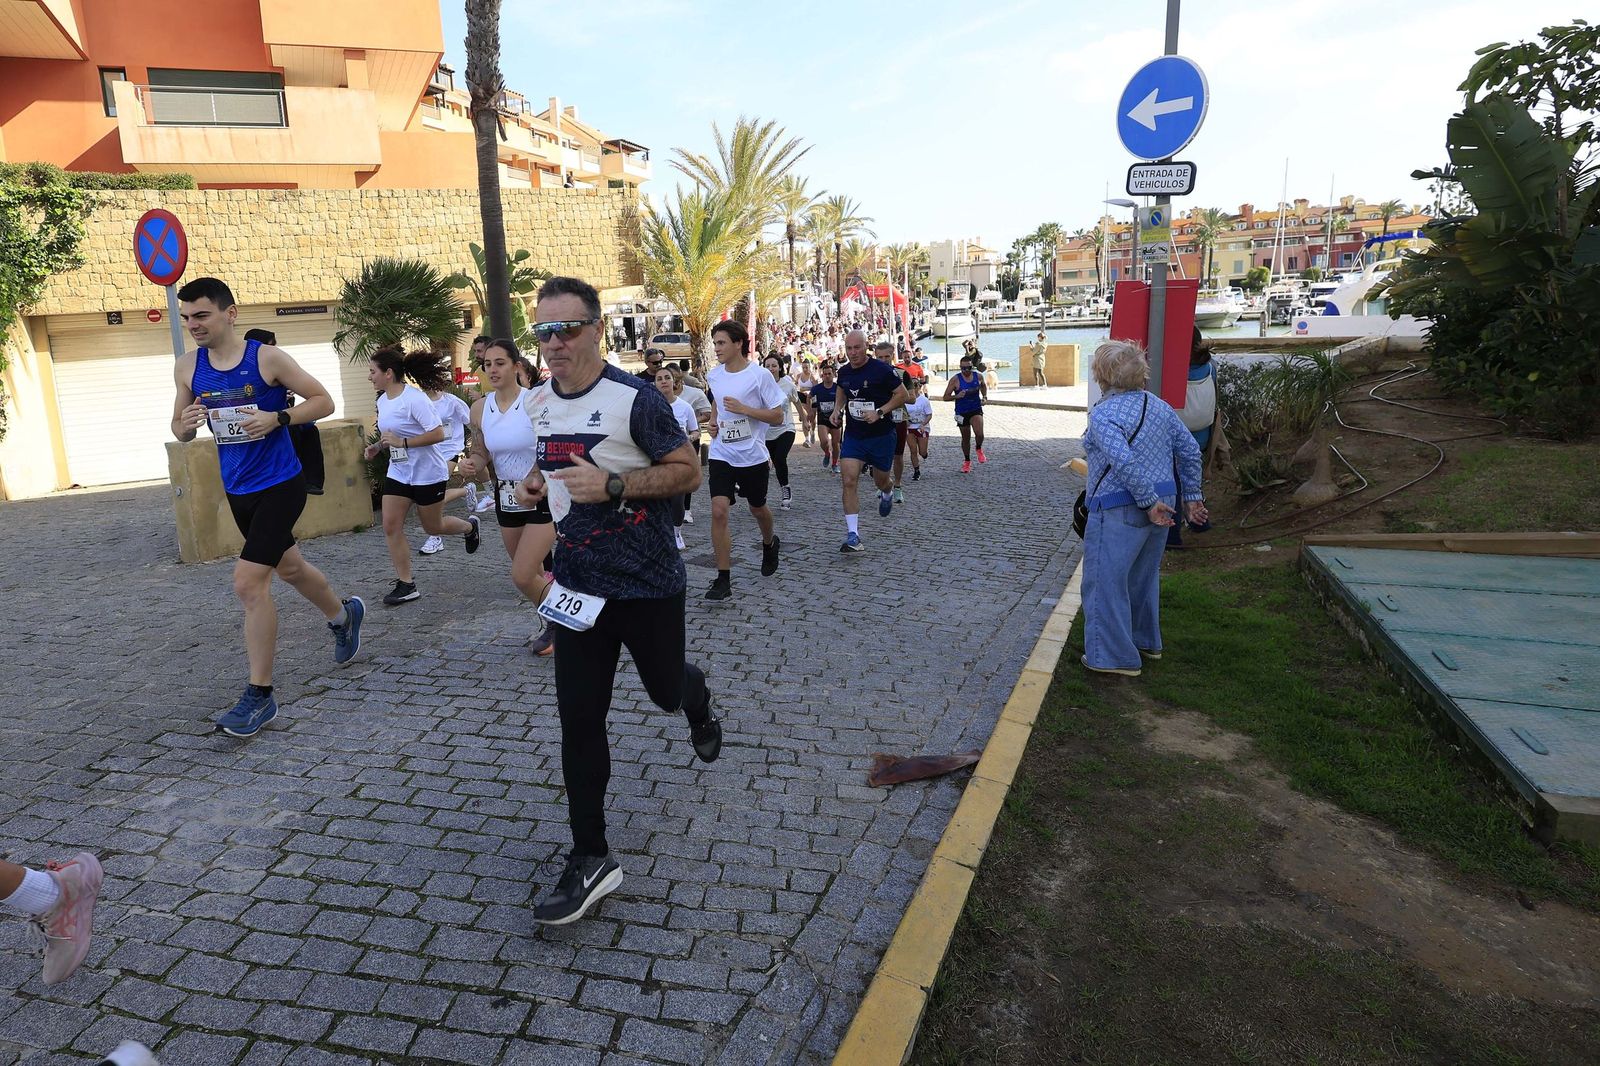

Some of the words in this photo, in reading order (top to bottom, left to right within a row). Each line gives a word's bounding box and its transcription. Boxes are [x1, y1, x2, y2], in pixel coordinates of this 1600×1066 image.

[1132, 170, 1173, 178] ENTRADA
[1176, 168, 1189, 177] DE
[1134, 180, 1184, 188] VEHICULOS
[228, 423, 242, 435] 82
[727, 430, 741, 438] 271
[555, 593, 582, 616] 219
